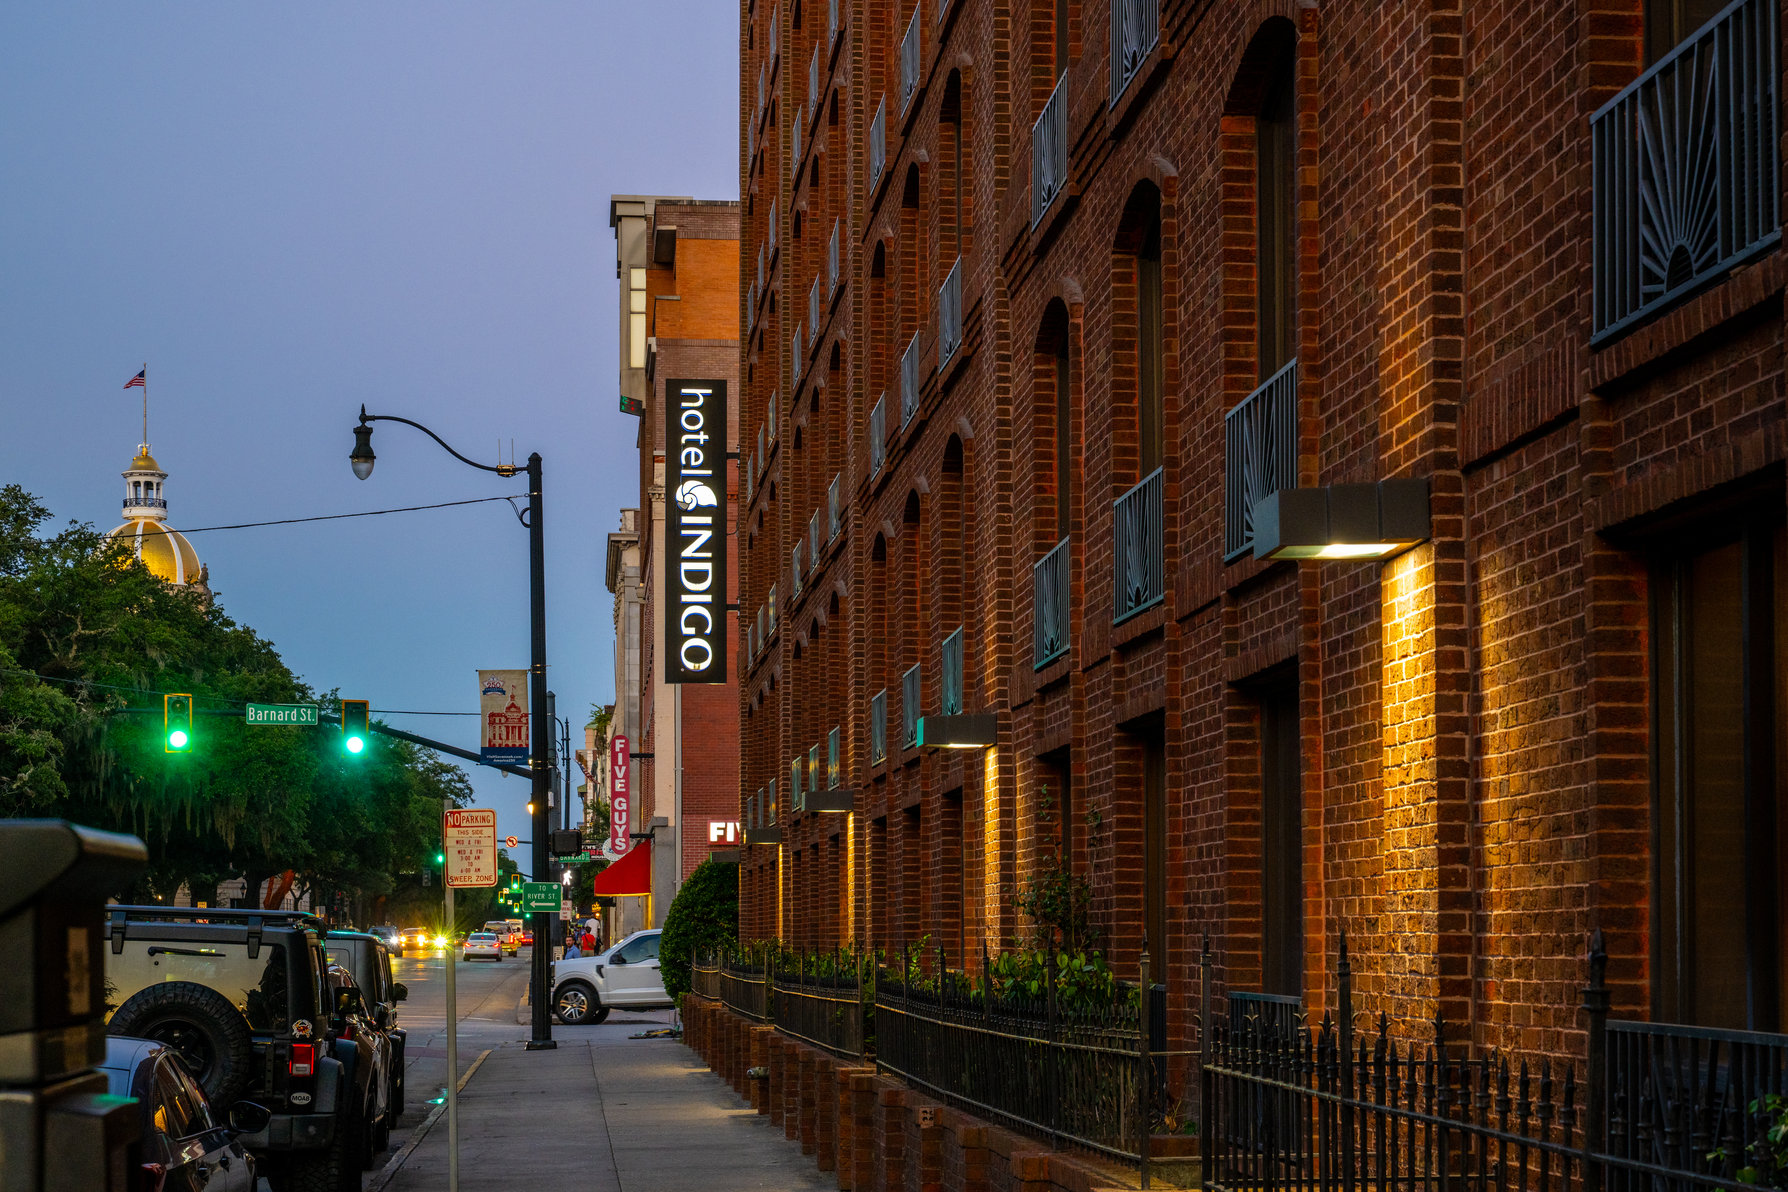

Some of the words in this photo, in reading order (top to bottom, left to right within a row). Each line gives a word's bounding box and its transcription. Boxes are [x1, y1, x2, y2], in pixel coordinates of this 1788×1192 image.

[681, 388, 712, 477] hotel
[681, 516, 713, 672] INDIGO
[248, 707, 297, 721] Barnard
[300, 708, 315, 722] St.
[614, 739, 626, 792] FIVE
[448, 813, 460, 826] NO
[461, 815, 491, 824] PARKING
[614, 797, 627, 851] GUYS
[449, 875, 473, 883] SWEEP
[475, 874, 494, 882] ZONE
